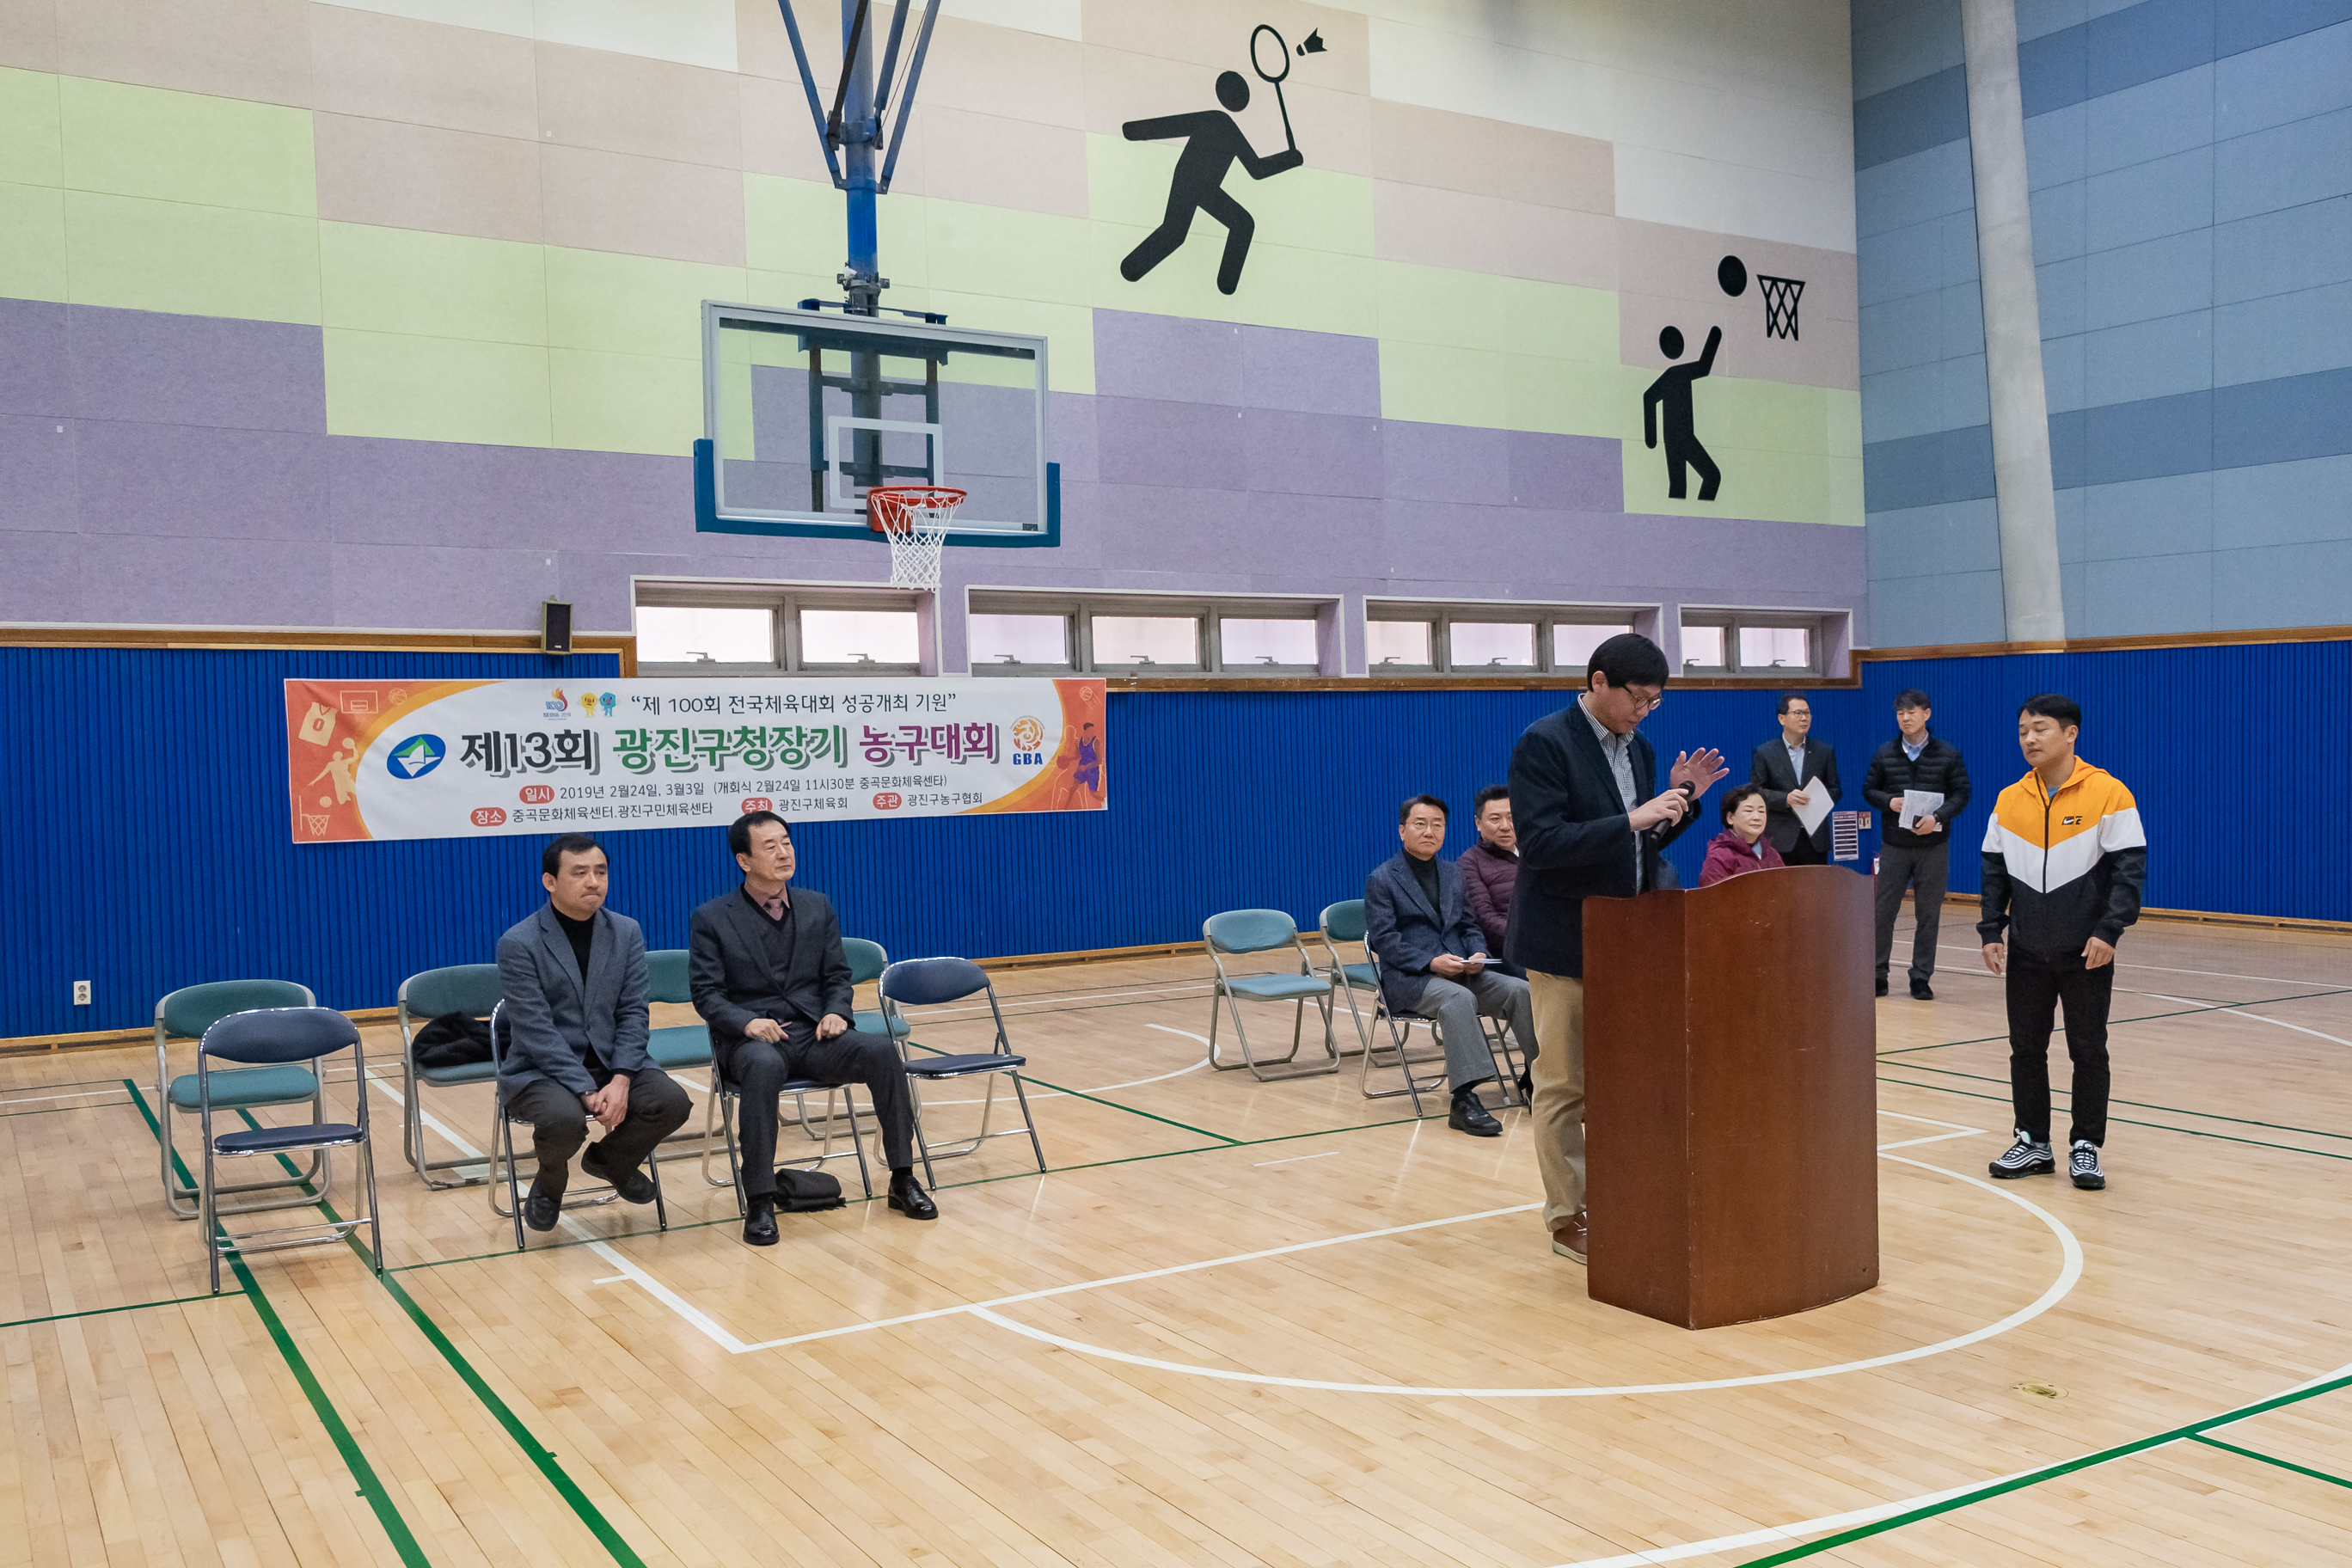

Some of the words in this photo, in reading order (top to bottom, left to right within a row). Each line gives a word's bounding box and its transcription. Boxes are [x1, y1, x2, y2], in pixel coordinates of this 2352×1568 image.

[667, 695, 721, 715] 100회
[727, 694, 836, 715] 전국체육대회
[841, 693, 909, 714] 성공개최
[460, 728, 597, 775] 제13회
[612, 724, 844, 772] 광진구청장기
[860, 721, 997, 767] 농구대회
[1012, 752, 1044, 765] GBA
[524, 787, 551, 802] 일시
[560, 786, 605, 799] 2019년
[609, 783, 661, 799] 2월24일,
[665, 781, 705, 796] 3월3일
[713, 780, 752, 795] (개회식
[756, 779, 801, 793] 2월24일
[805, 777, 855, 791] 11시30분
[475, 810, 503, 825] 장소
[744, 799, 769, 812] 주최
[778, 797, 848, 812] 광진구체육회
[876, 794, 899, 808] 주관
[907, 792, 983, 806] 광진구농구협회
